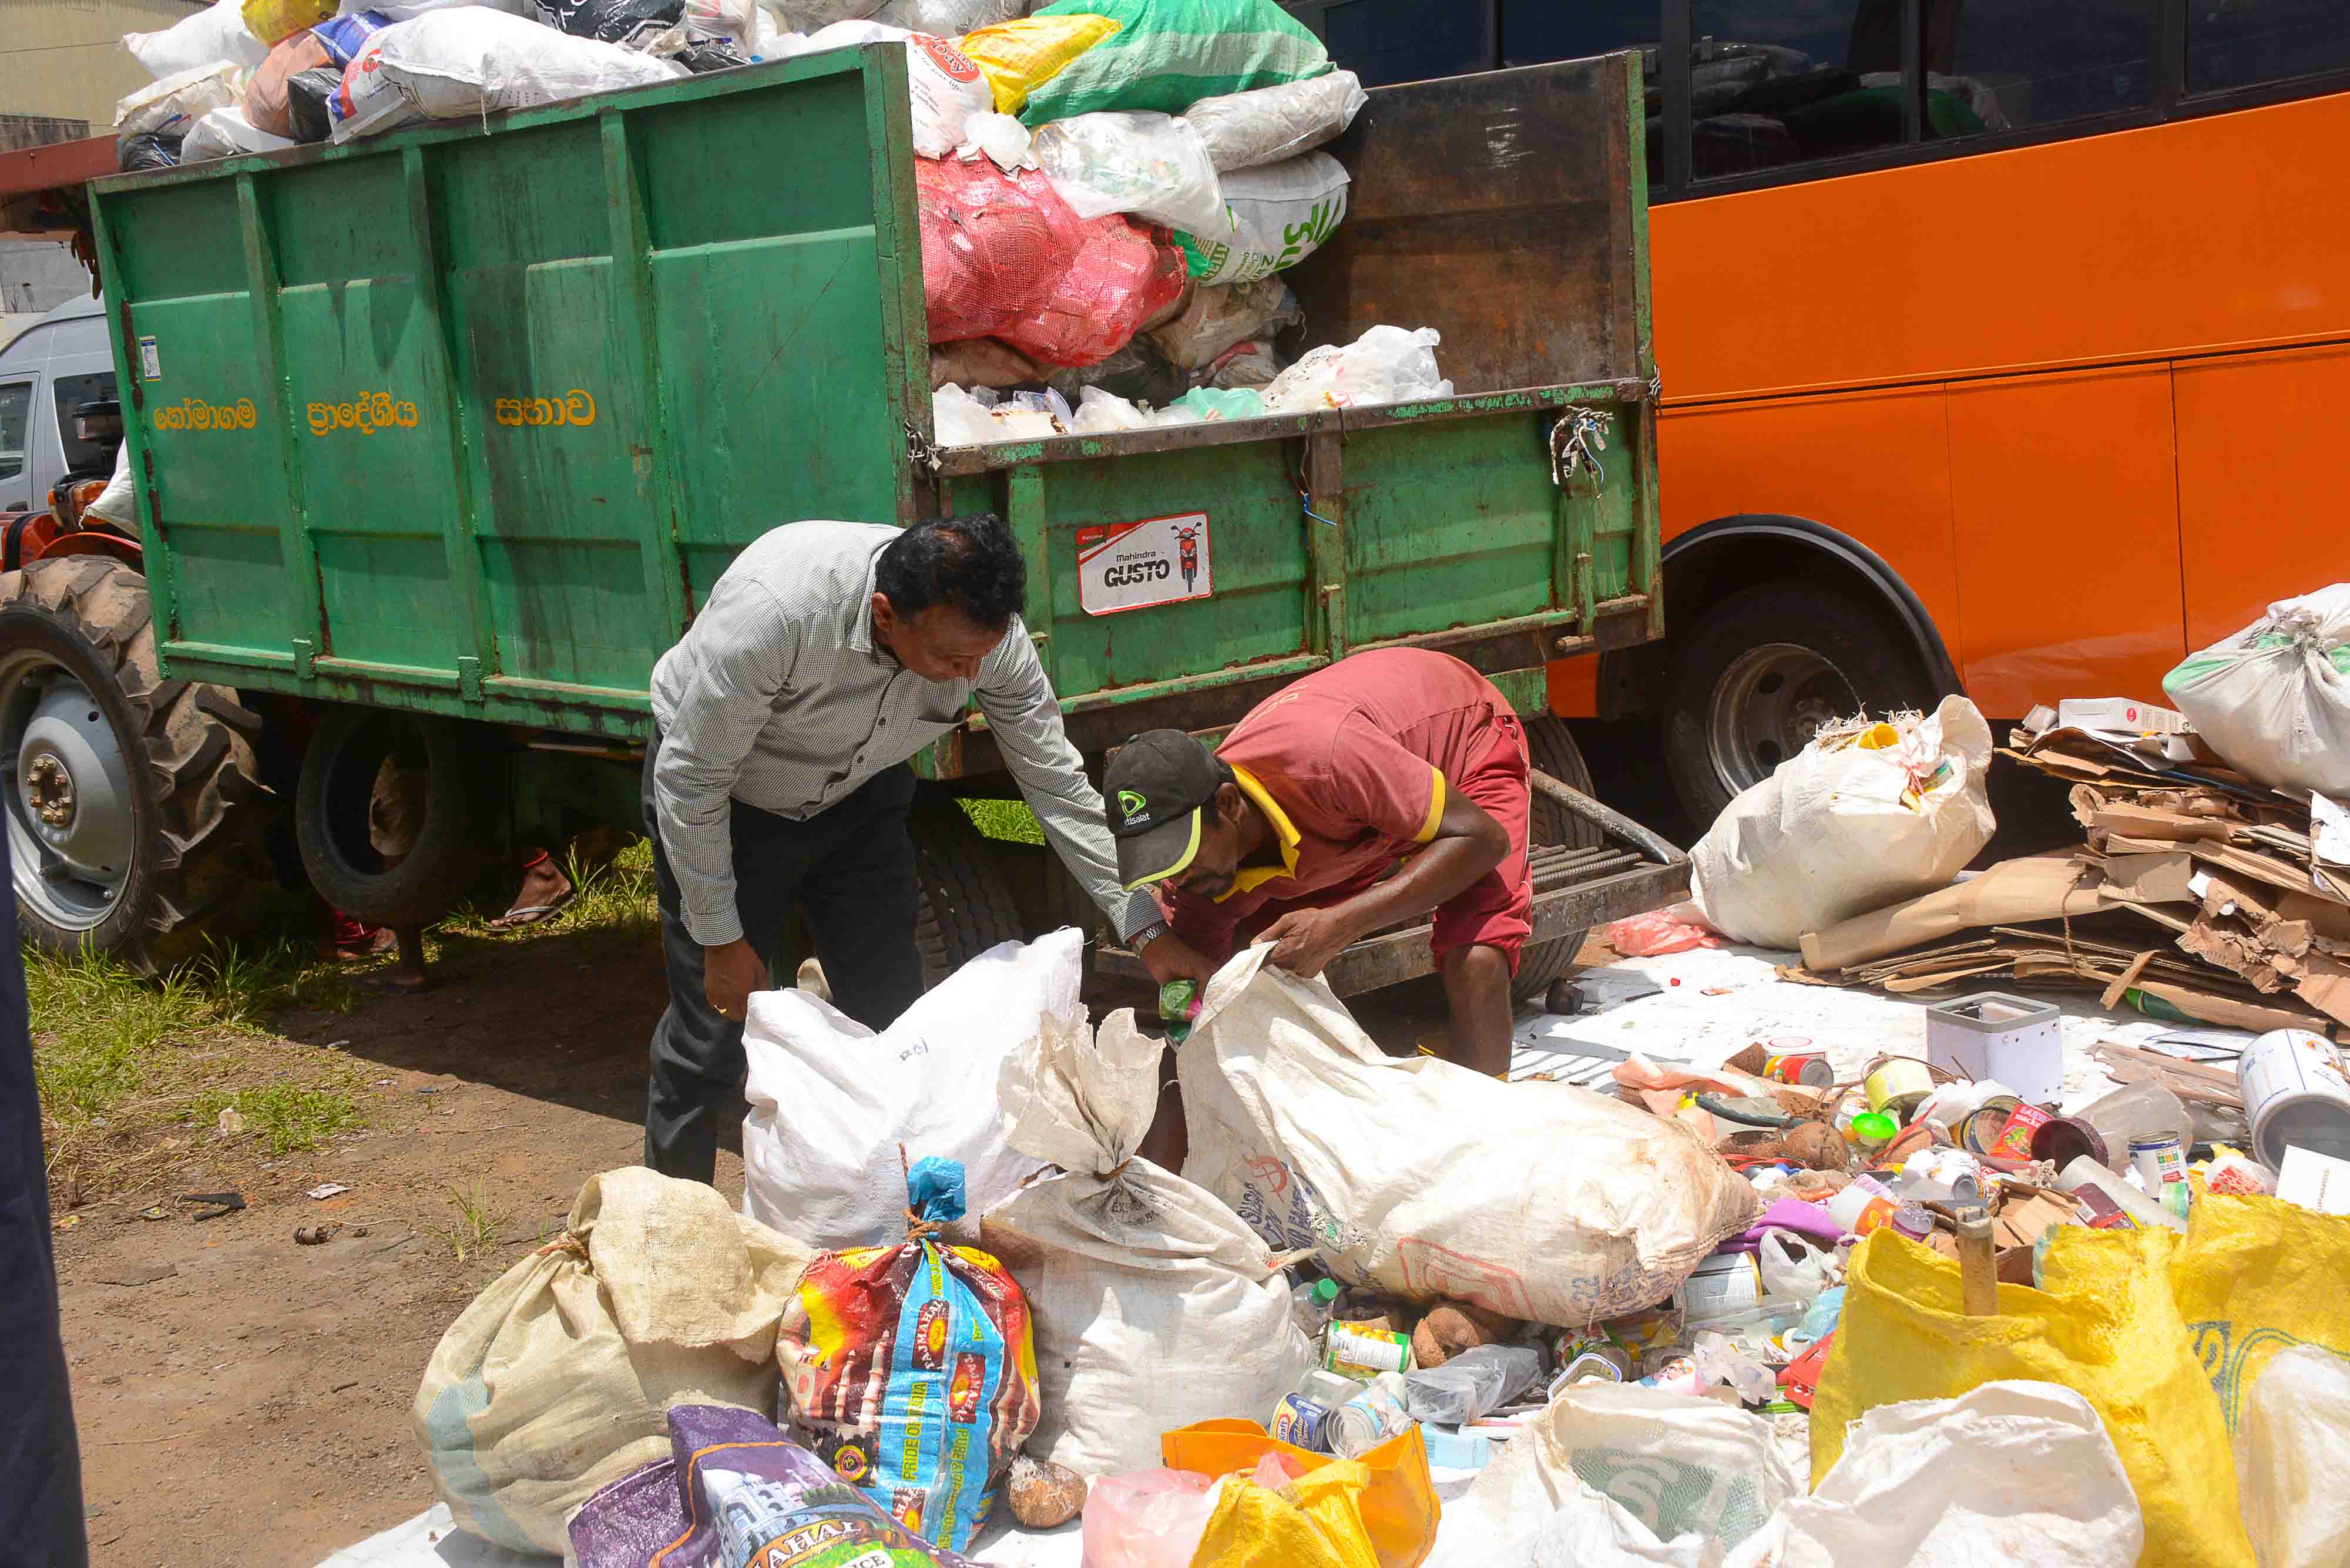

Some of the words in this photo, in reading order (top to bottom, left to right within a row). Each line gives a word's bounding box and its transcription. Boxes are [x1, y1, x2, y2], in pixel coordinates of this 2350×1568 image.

[153, 397, 257, 431] හෝමාගම
[495, 388, 597, 428] සභාව
[1116, 550, 1156, 562] Mahindra
[1104, 559, 1170, 587] GUSTO
[1123, 812, 1151, 826] etisalat
[2015, 1114, 2042, 1128] macke
[916, 1300, 944, 1369] TAJMAHAL
[952, 1429, 969, 1460] PURE
[1278, 1421, 1288, 1441] Kraft
[902, 1439, 919, 1480] PRIDE
